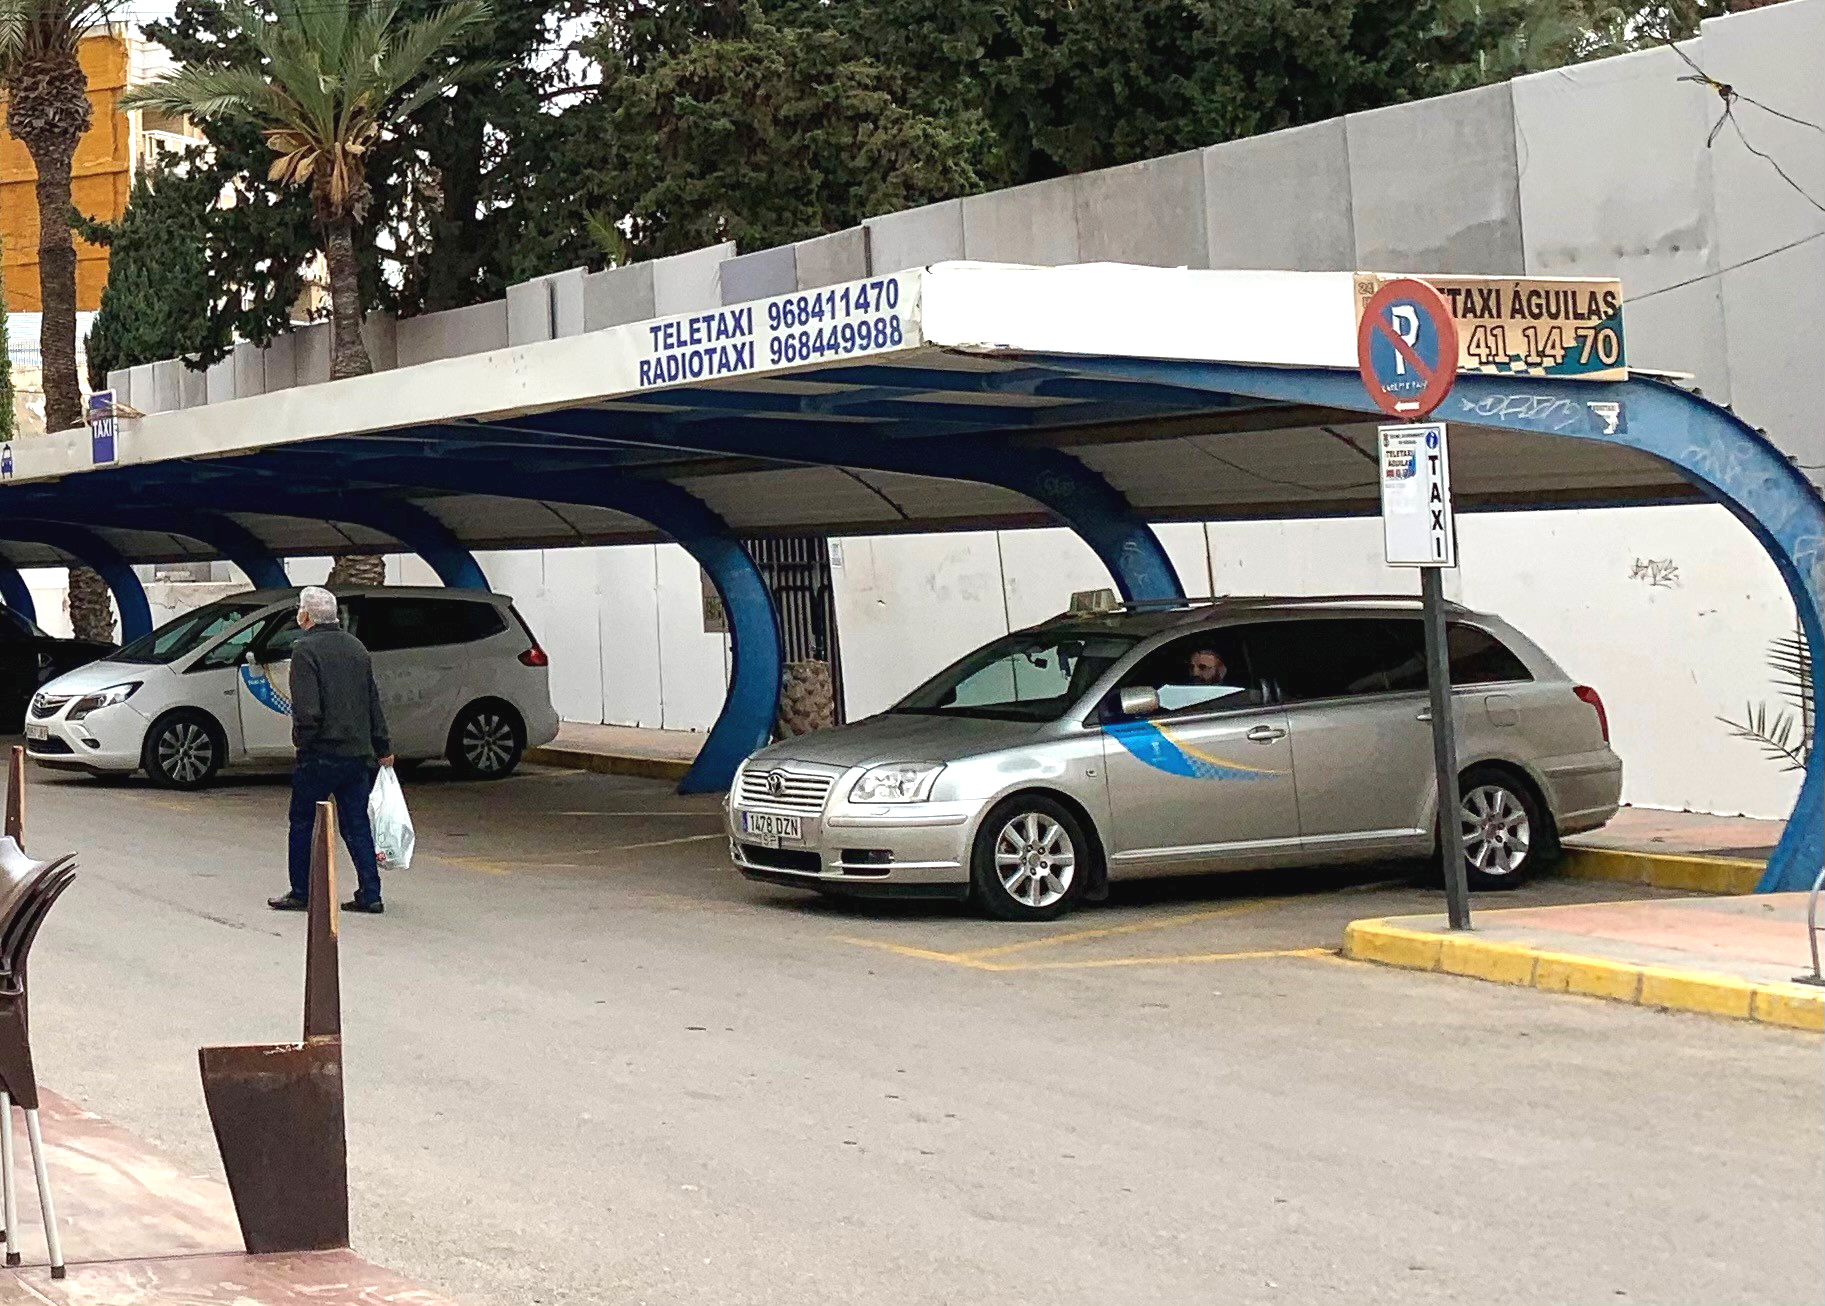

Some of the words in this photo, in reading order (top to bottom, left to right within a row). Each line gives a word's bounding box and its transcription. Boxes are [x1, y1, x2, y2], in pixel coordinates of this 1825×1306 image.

[650, 307, 753, 352] TELETAXI
[768, 278, 899, 331] 968411470
[1437, 287, 1502, 319] TAXI
[1510, 282, 1618, 320] ÁGUILAS
[639, 341, 755, 387] RADIOTAXI
[770, 315, 903, 365] 968449988
[1467, 325, 1511, 365] 41
[1523, 326, 1566, 366] 14
[1575, 327, 1619, 366] 70
[92, 419, 112, 438] TAXI
[1428, 455, 1443, 558] TAXI
[750, 815, 773, 833] 1478
[776, 817, 798, 837] DZN
